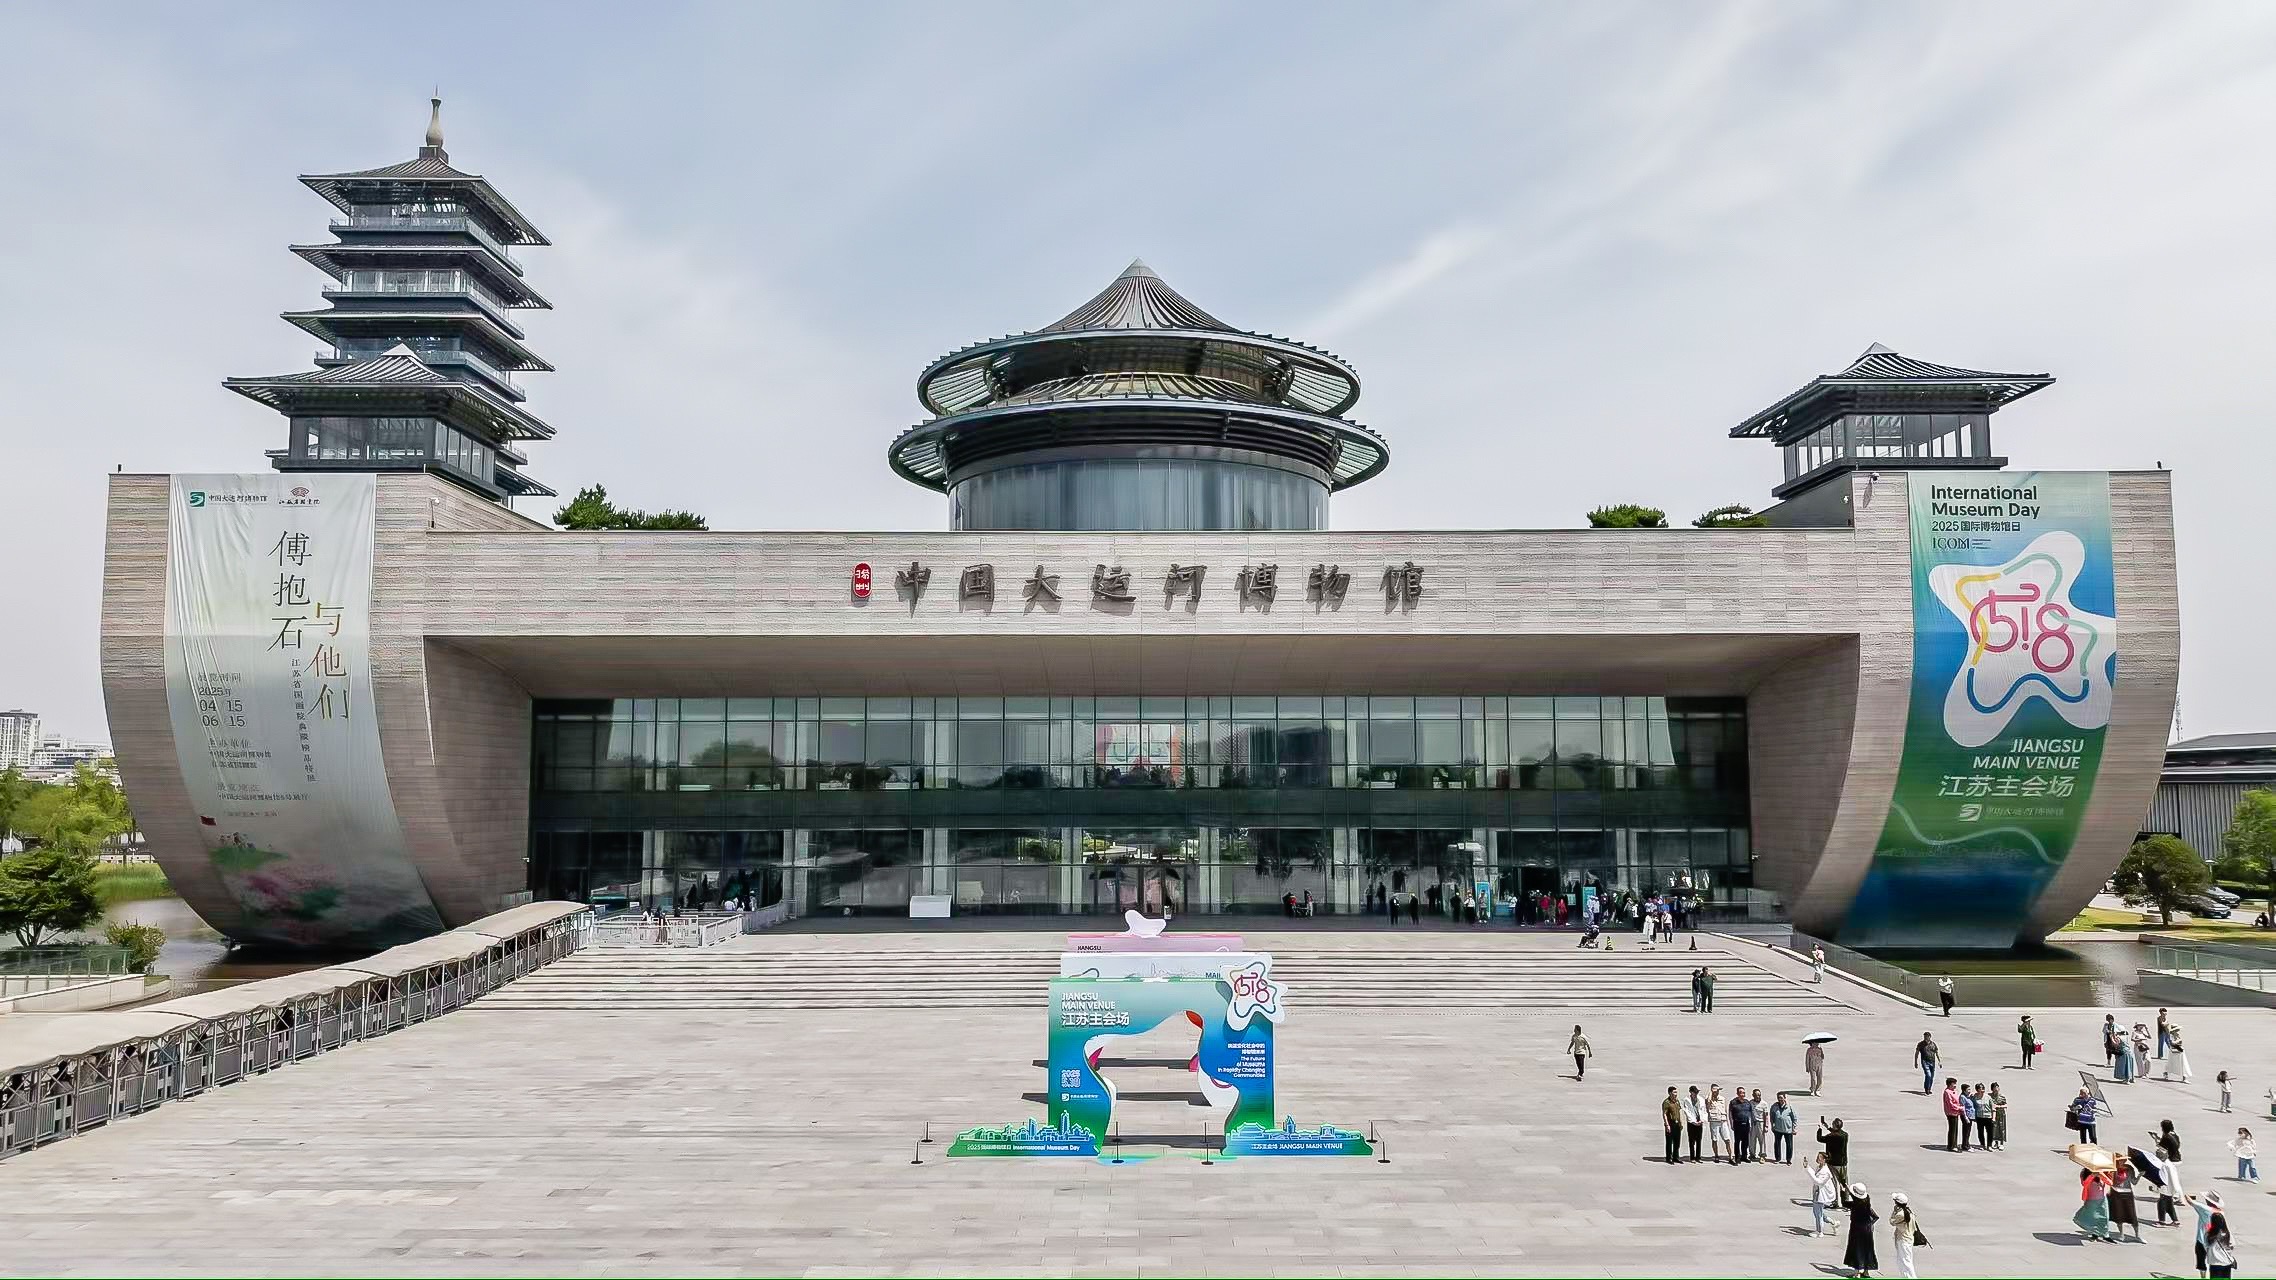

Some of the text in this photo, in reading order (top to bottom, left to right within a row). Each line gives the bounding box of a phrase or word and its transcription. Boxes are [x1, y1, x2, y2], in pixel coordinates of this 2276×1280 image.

[1931, 484, 2037, 500] International
[1932, 502, 2040, 519] Museum Day
[1932, 537, 1970, 550] ICOM
[267, 529, 312, 652] 傅抱石
[303, 601, 350, 720] 与他们
[226, 699, 244, 712] 15
[202, 714, 246, 727] 06 15
[2010, 738, 2085, 754] JIANGSU
[1972, 755, 2081, 770] MAIN VENUE
[1937, 774, 2076, 798] 江苏主会场
[1061, 992, 1099, 1001] JIANGSU
[1061, 1001, 1116, 1010] MAIN VENUE
[1061, 1012, 1130, 1026] 江苏主会场
[1069, 1144, 1080, 1152] Day
